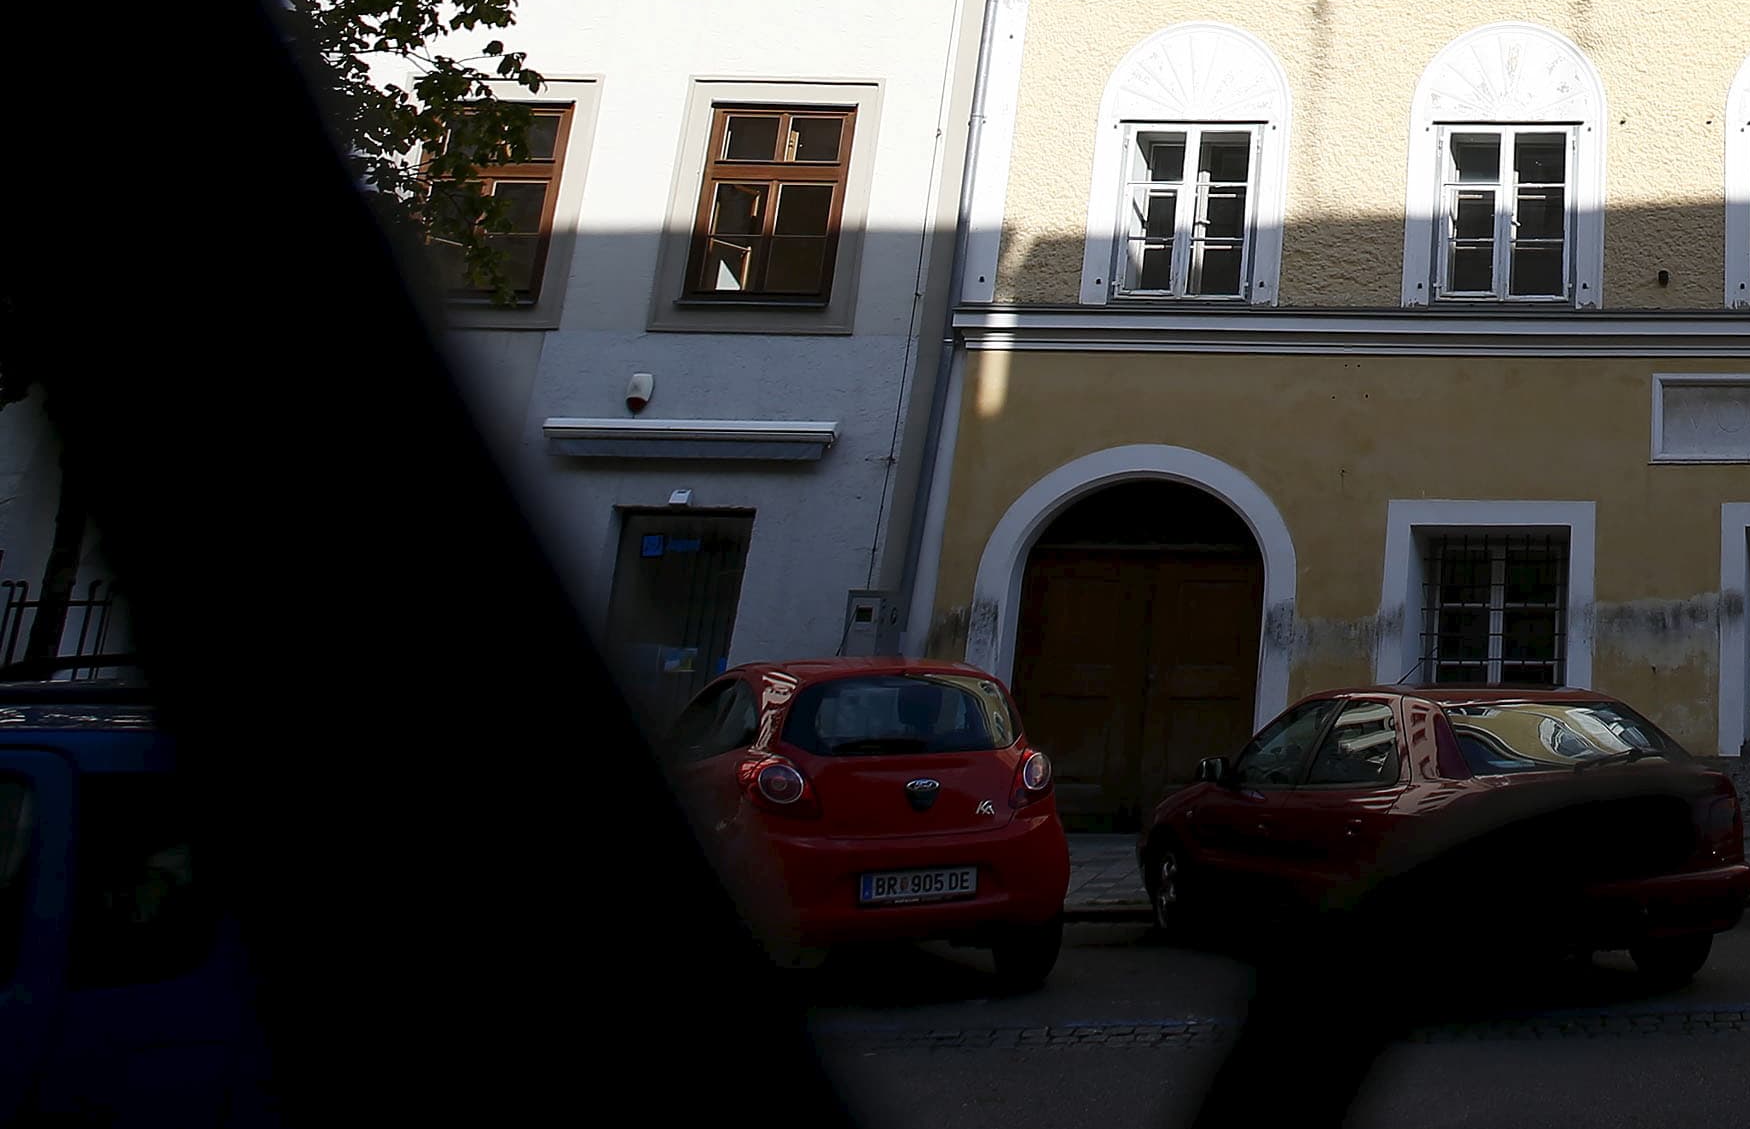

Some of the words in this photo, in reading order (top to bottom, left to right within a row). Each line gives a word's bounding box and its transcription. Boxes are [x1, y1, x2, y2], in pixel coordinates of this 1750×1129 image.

[875, 876, 898, 896] BR
[911, 873, 944, 893] 905
[948, 871, 970, 891] DE
